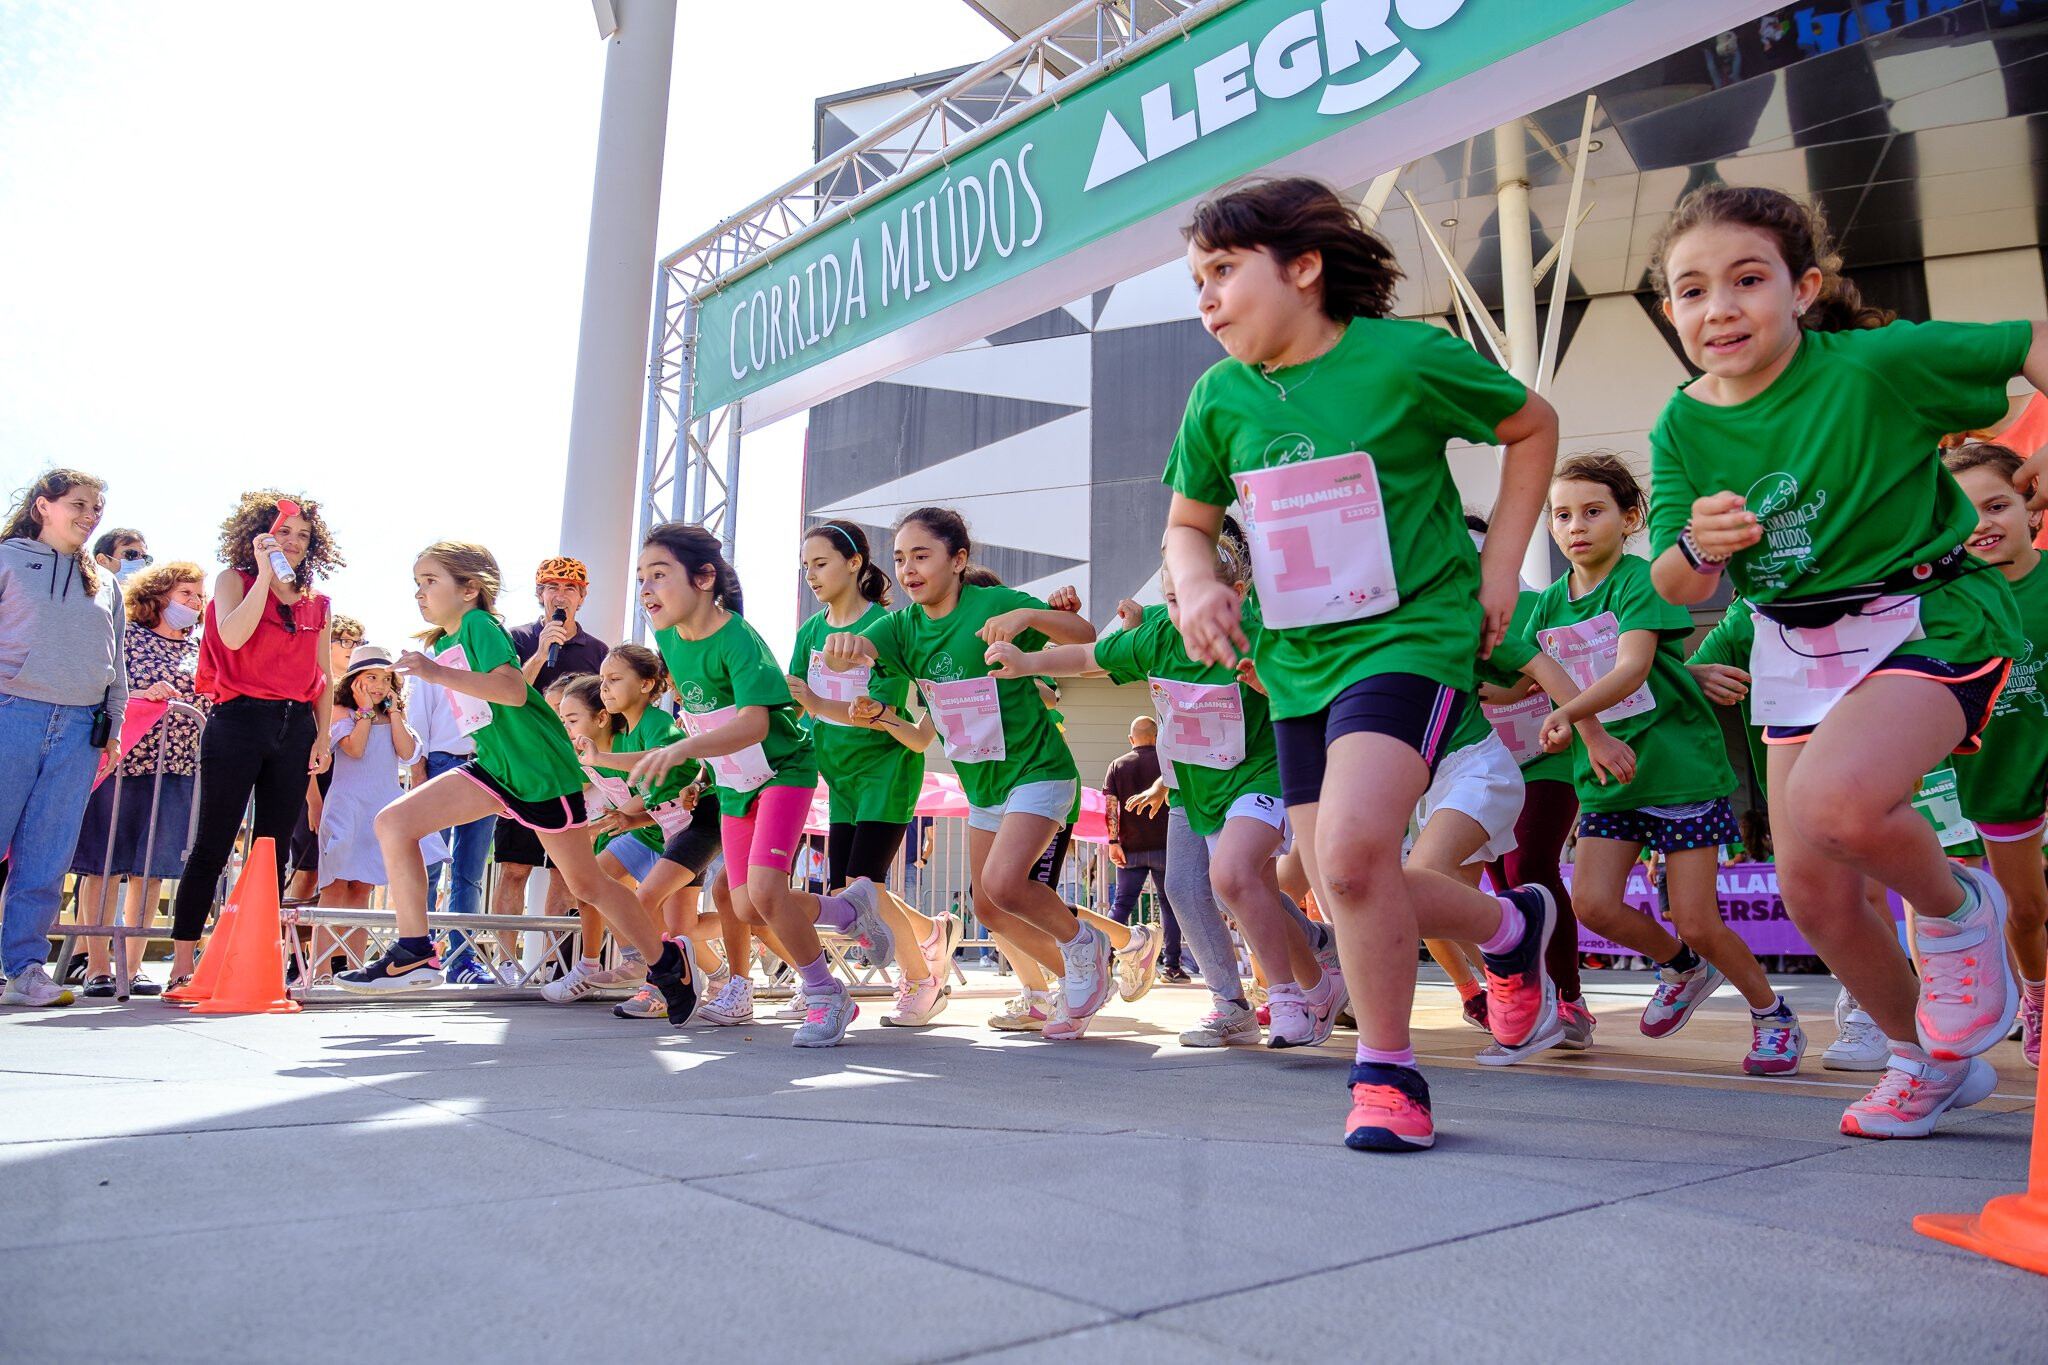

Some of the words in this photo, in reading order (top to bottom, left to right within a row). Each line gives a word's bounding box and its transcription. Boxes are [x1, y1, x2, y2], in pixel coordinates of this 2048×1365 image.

[730, 237, 867, 380] CORRIDA
[881, 143, 1043, 307] MIÚDOS
[1271, 485, 1353, 511] BENJAMINS
[1355, 483, 1367, 495] A
[1763, 509, 1806, 532] CORRIDA
[1767, 527, 1812, 549] MIÚDOS
[1267, 525, 1332, 593] 1
[1772, 546, 1812, 558] ALEGRO
[1801, 624, 1861, 690] 1
[940, 695, 985, 706] BENJAMINS
[985, 694, 992, 702] A
[1178, 701, 1228, 711] BENJAMINS
[1492, 698, 1538, 714] BENJAMINS
[1538, 696, 1545, 704] A
[941, 713, 972, 747] 1
[1173, 714, 1211, 747] 1
[1919, 782, 1956, 797] BAMBIS
[1718, 894, 1791, 921] ERSÃ
